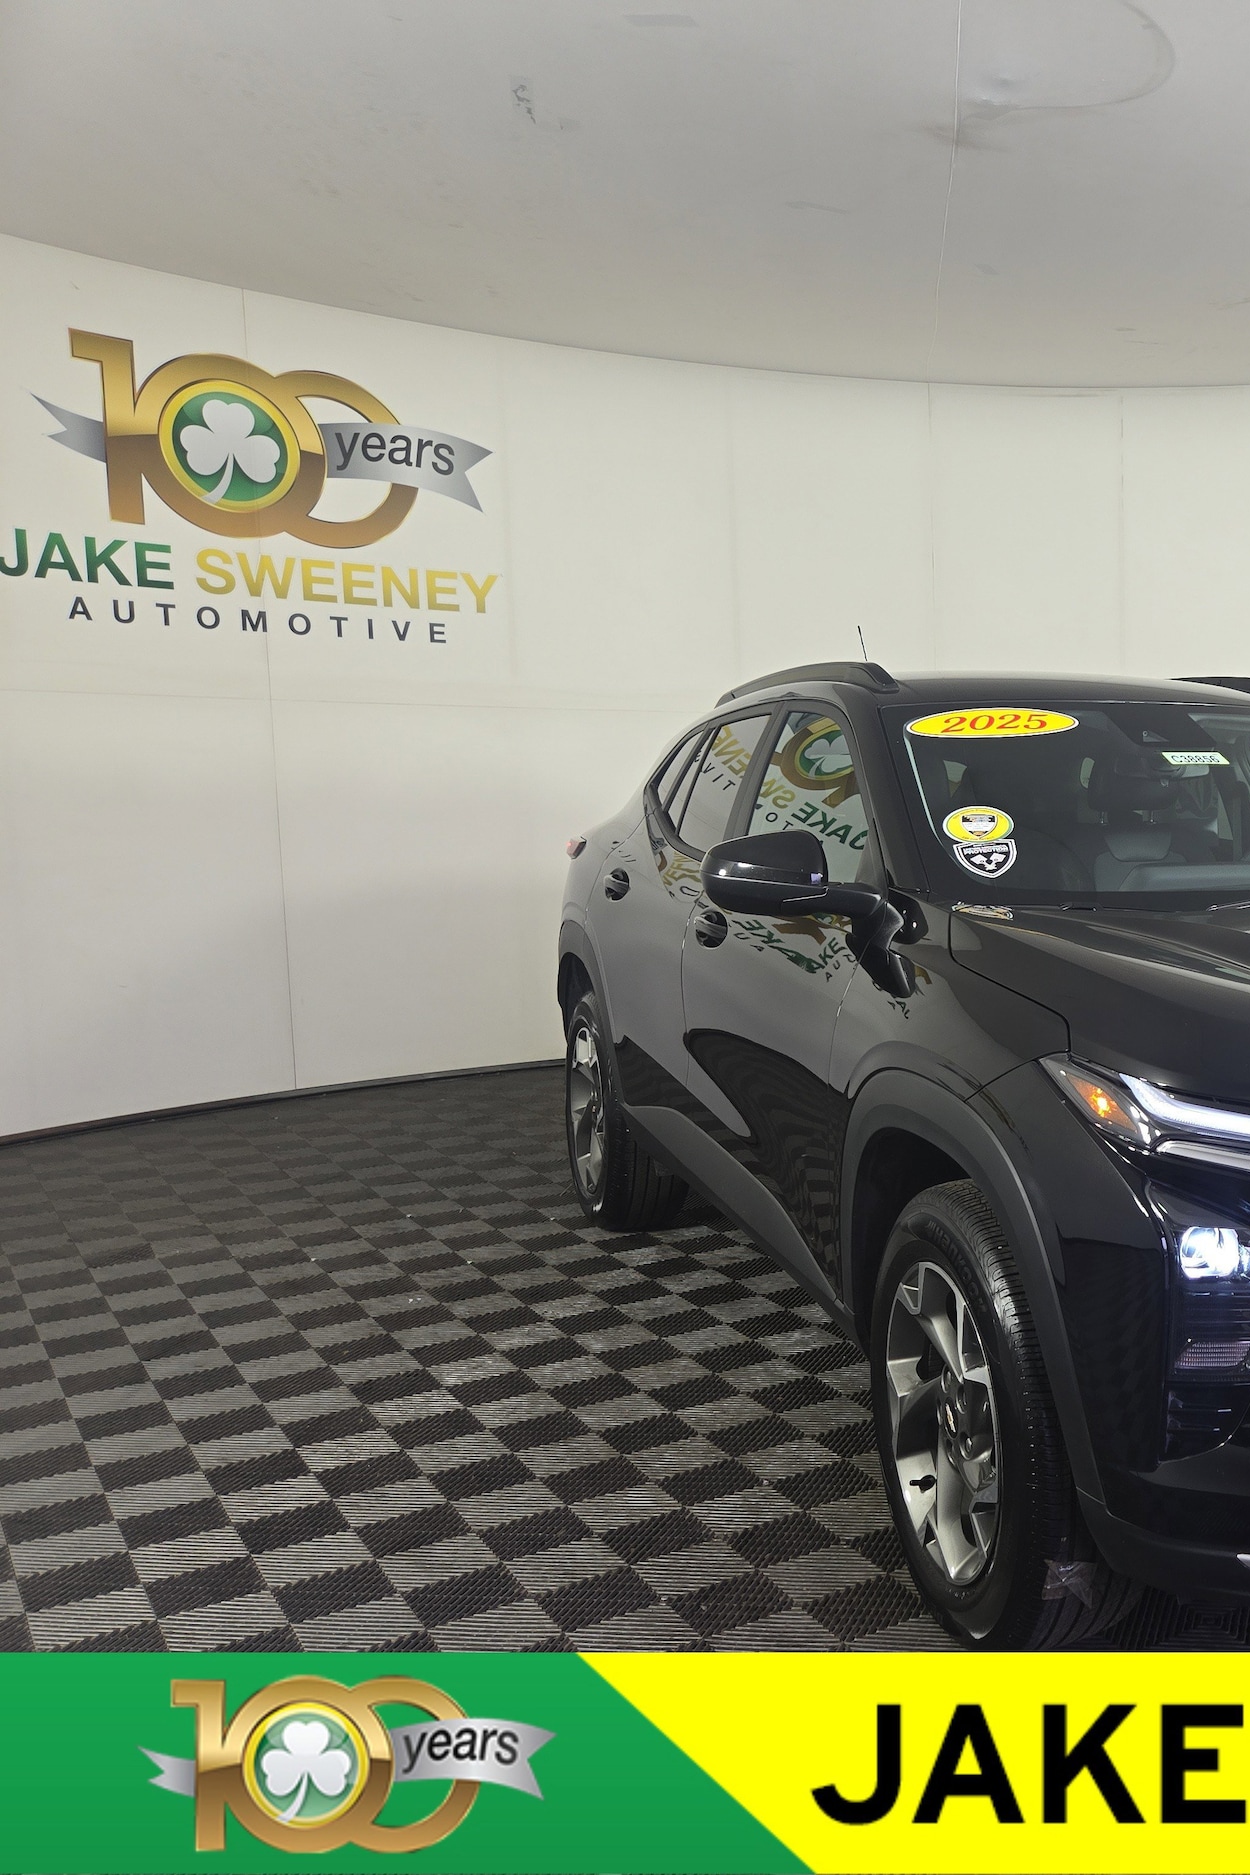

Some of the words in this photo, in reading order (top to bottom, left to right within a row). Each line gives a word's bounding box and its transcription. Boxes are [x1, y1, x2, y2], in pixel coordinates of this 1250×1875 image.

[68, 327, 418, 549] 100
[335, 431, 455, 476] years
[0, 528, 174, 590] JAKE
[195, 548, 499, 614] SWEENEY
[69, 596, 447, 643] AUTOMOTIVE
[941, 713, 1048, 733] 2025
